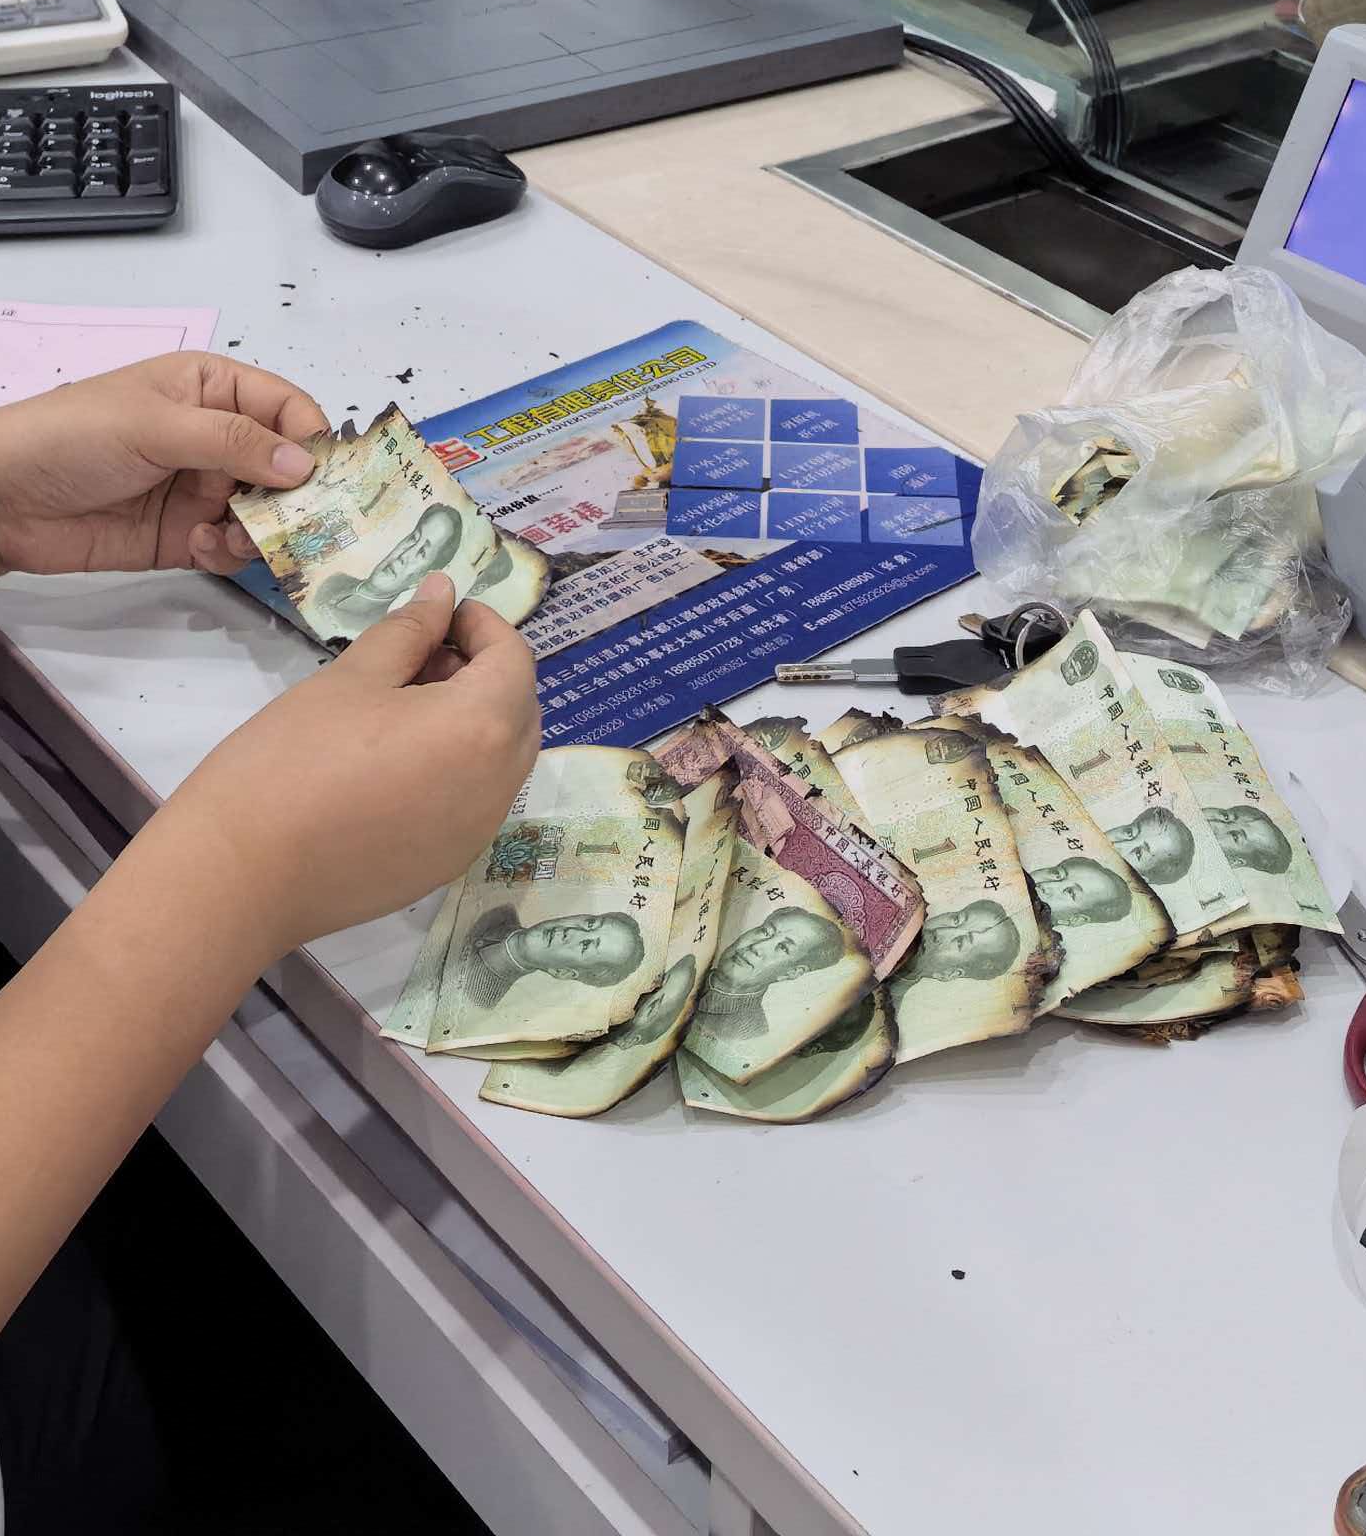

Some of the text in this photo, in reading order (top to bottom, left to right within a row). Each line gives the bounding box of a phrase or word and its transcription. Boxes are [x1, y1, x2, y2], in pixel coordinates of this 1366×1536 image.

[90, 90, 154, 101] logitech
[465, 345, 708, 449] 工程有限责任公司
[1099, 684, 1162, 799] 中国人民银行
[958, 777, 1001, 891] 中国人民银行
[998, 759, 1084, 851] 中国人民银行
[629, 817, 661, 910] 国人民银行
[824, 825, 903, 898] 中国人民银行
